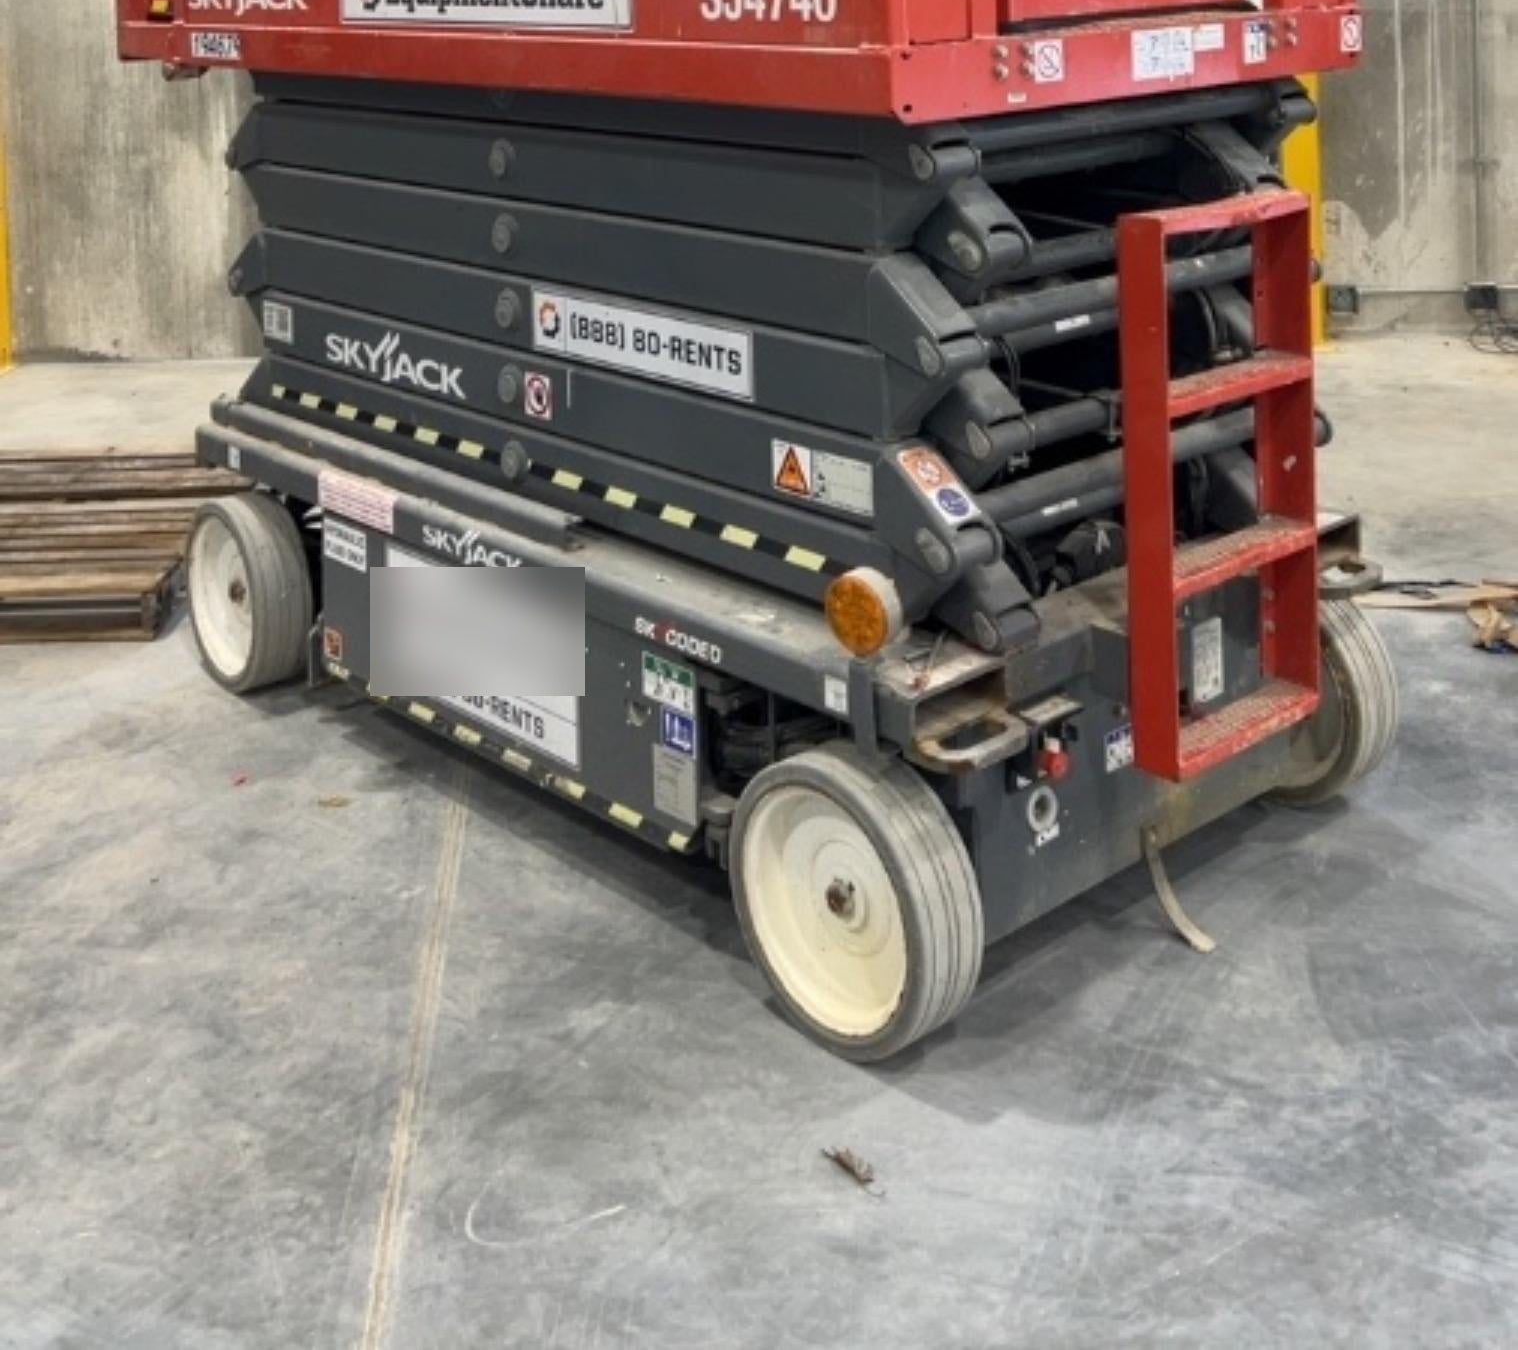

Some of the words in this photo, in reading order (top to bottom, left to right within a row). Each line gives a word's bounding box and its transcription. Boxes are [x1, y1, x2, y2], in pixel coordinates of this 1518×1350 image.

[325, 330, 467, 400] SKYJACK
[570, 311, 625, 350] (888)
[632, 328, 742, 376] 80-RENTS
